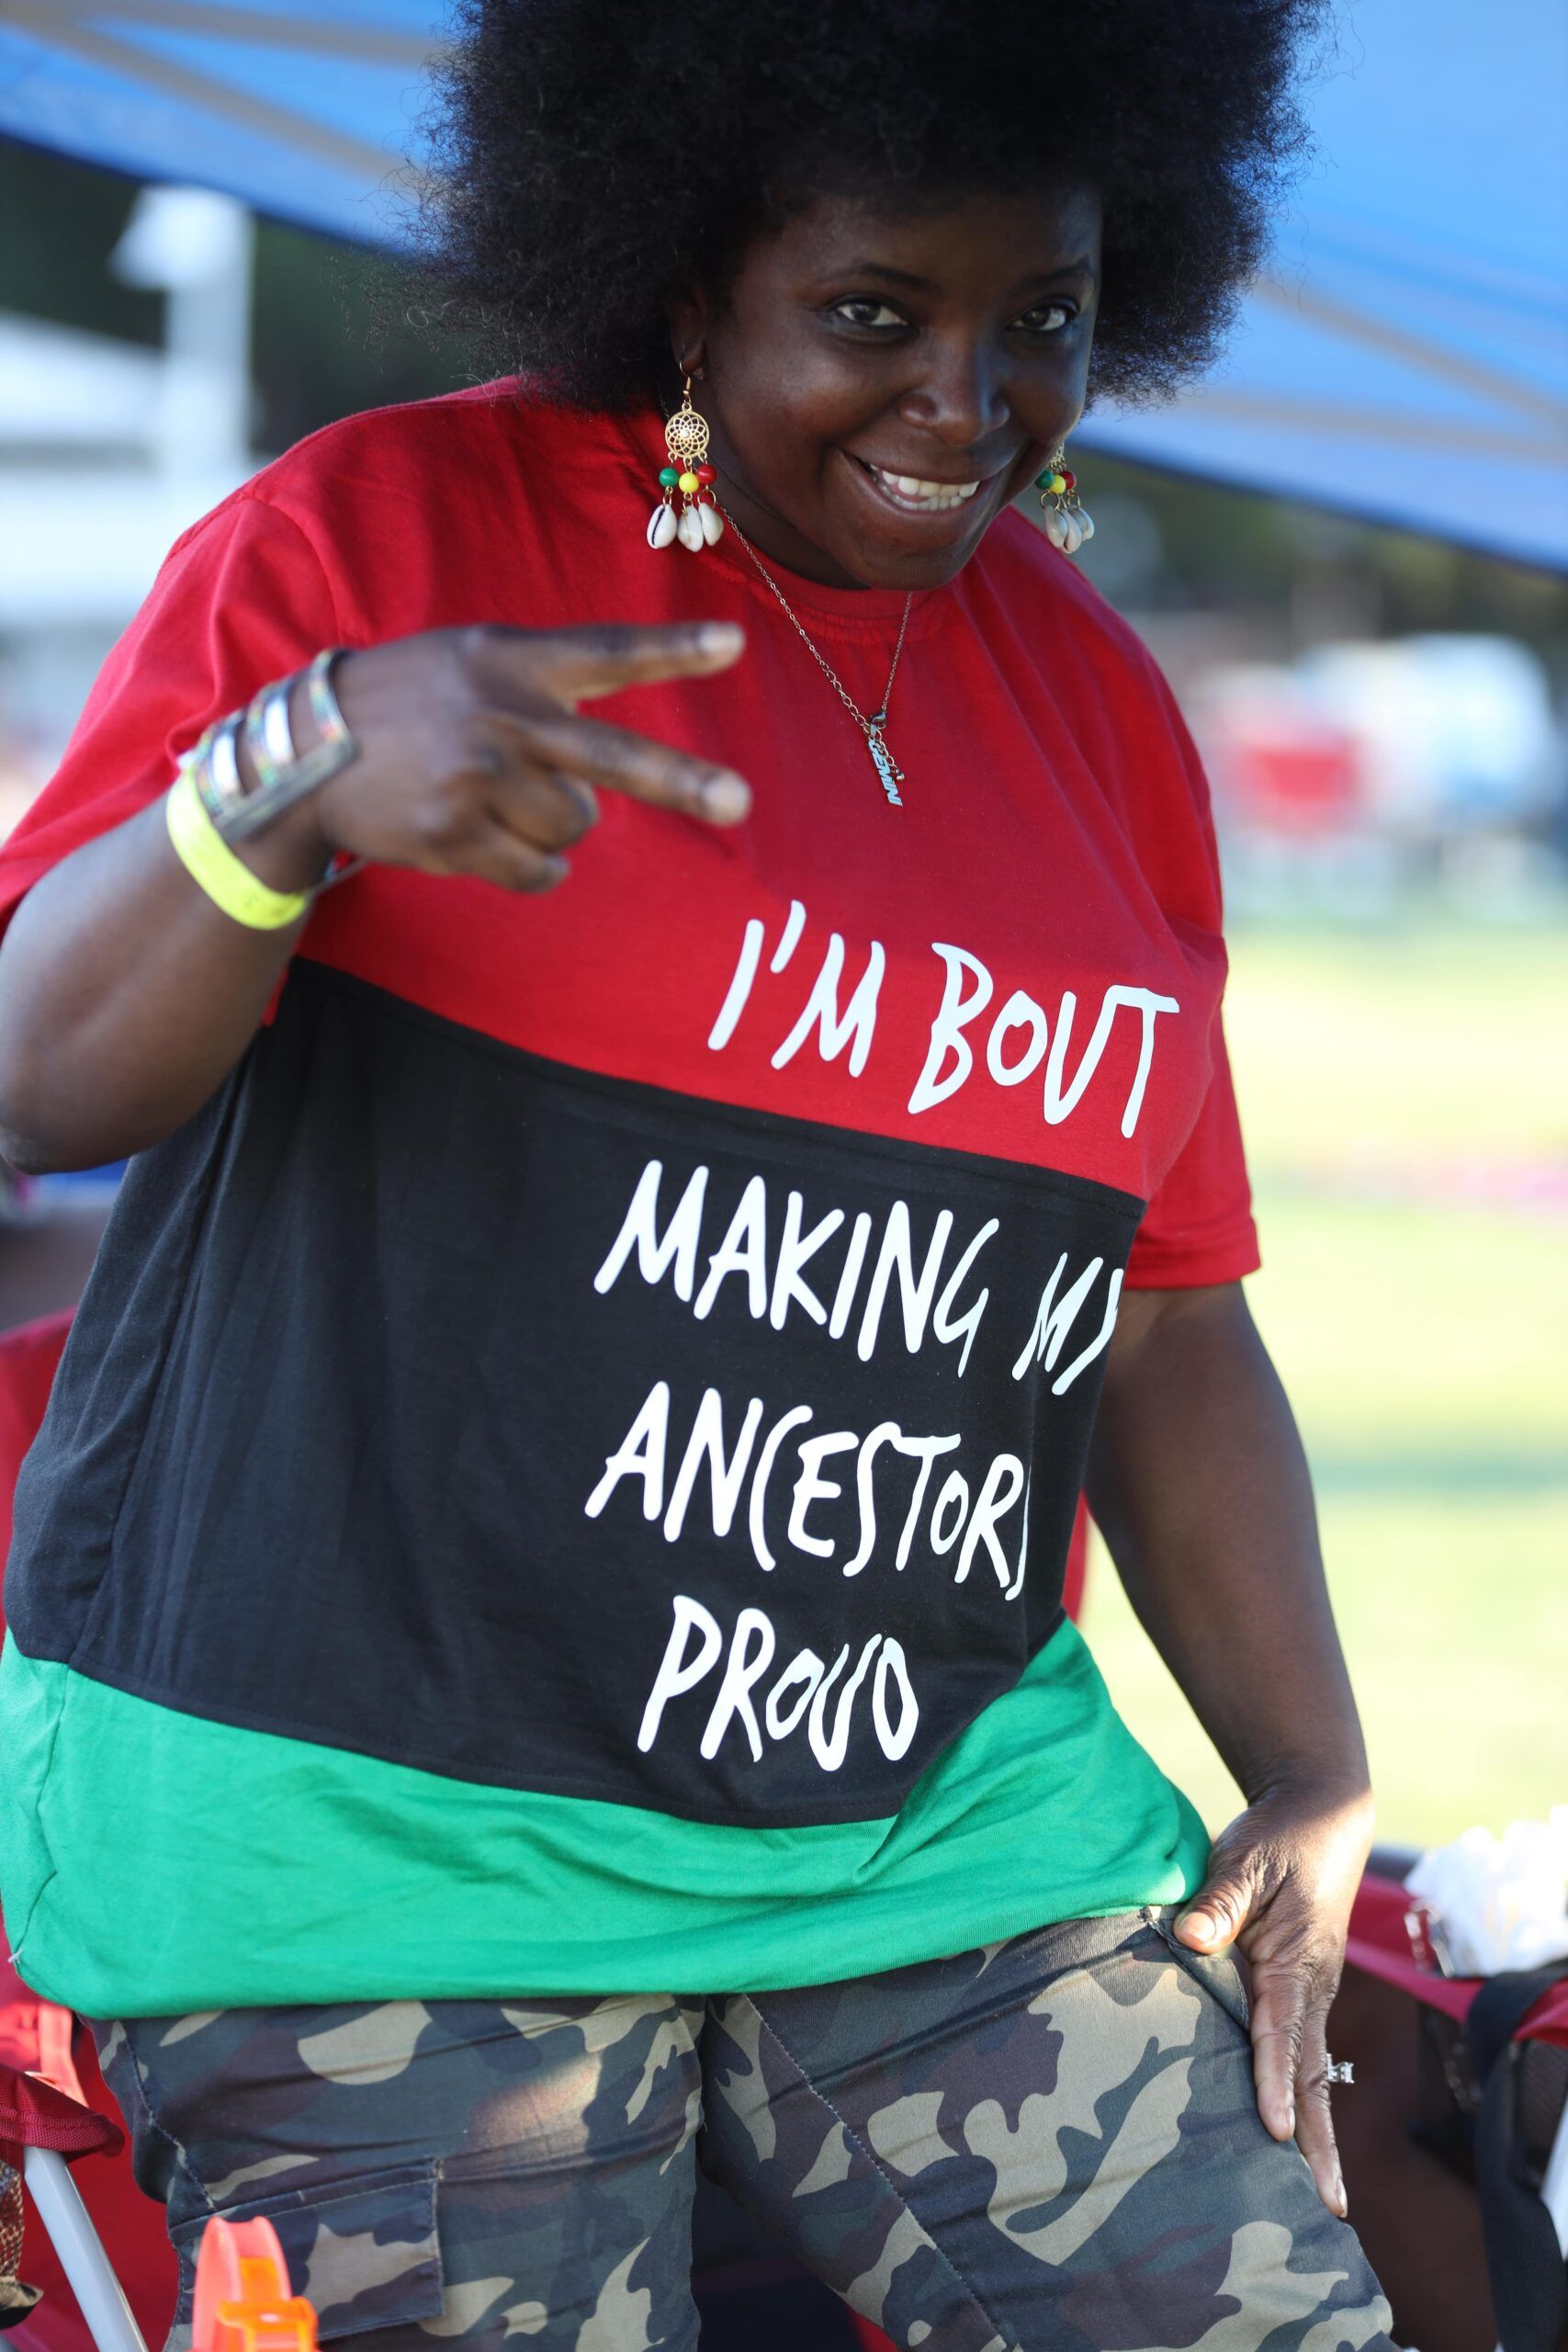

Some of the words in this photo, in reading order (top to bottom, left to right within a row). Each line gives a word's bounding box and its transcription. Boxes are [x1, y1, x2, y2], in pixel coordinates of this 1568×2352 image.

[707, 899, 886, 1078] I'M
[907, 942, 1180, 1139] BOUT
[593, 1159, 999, 1378] MAKING
[637, 1595, 919, 1772] PROUD
